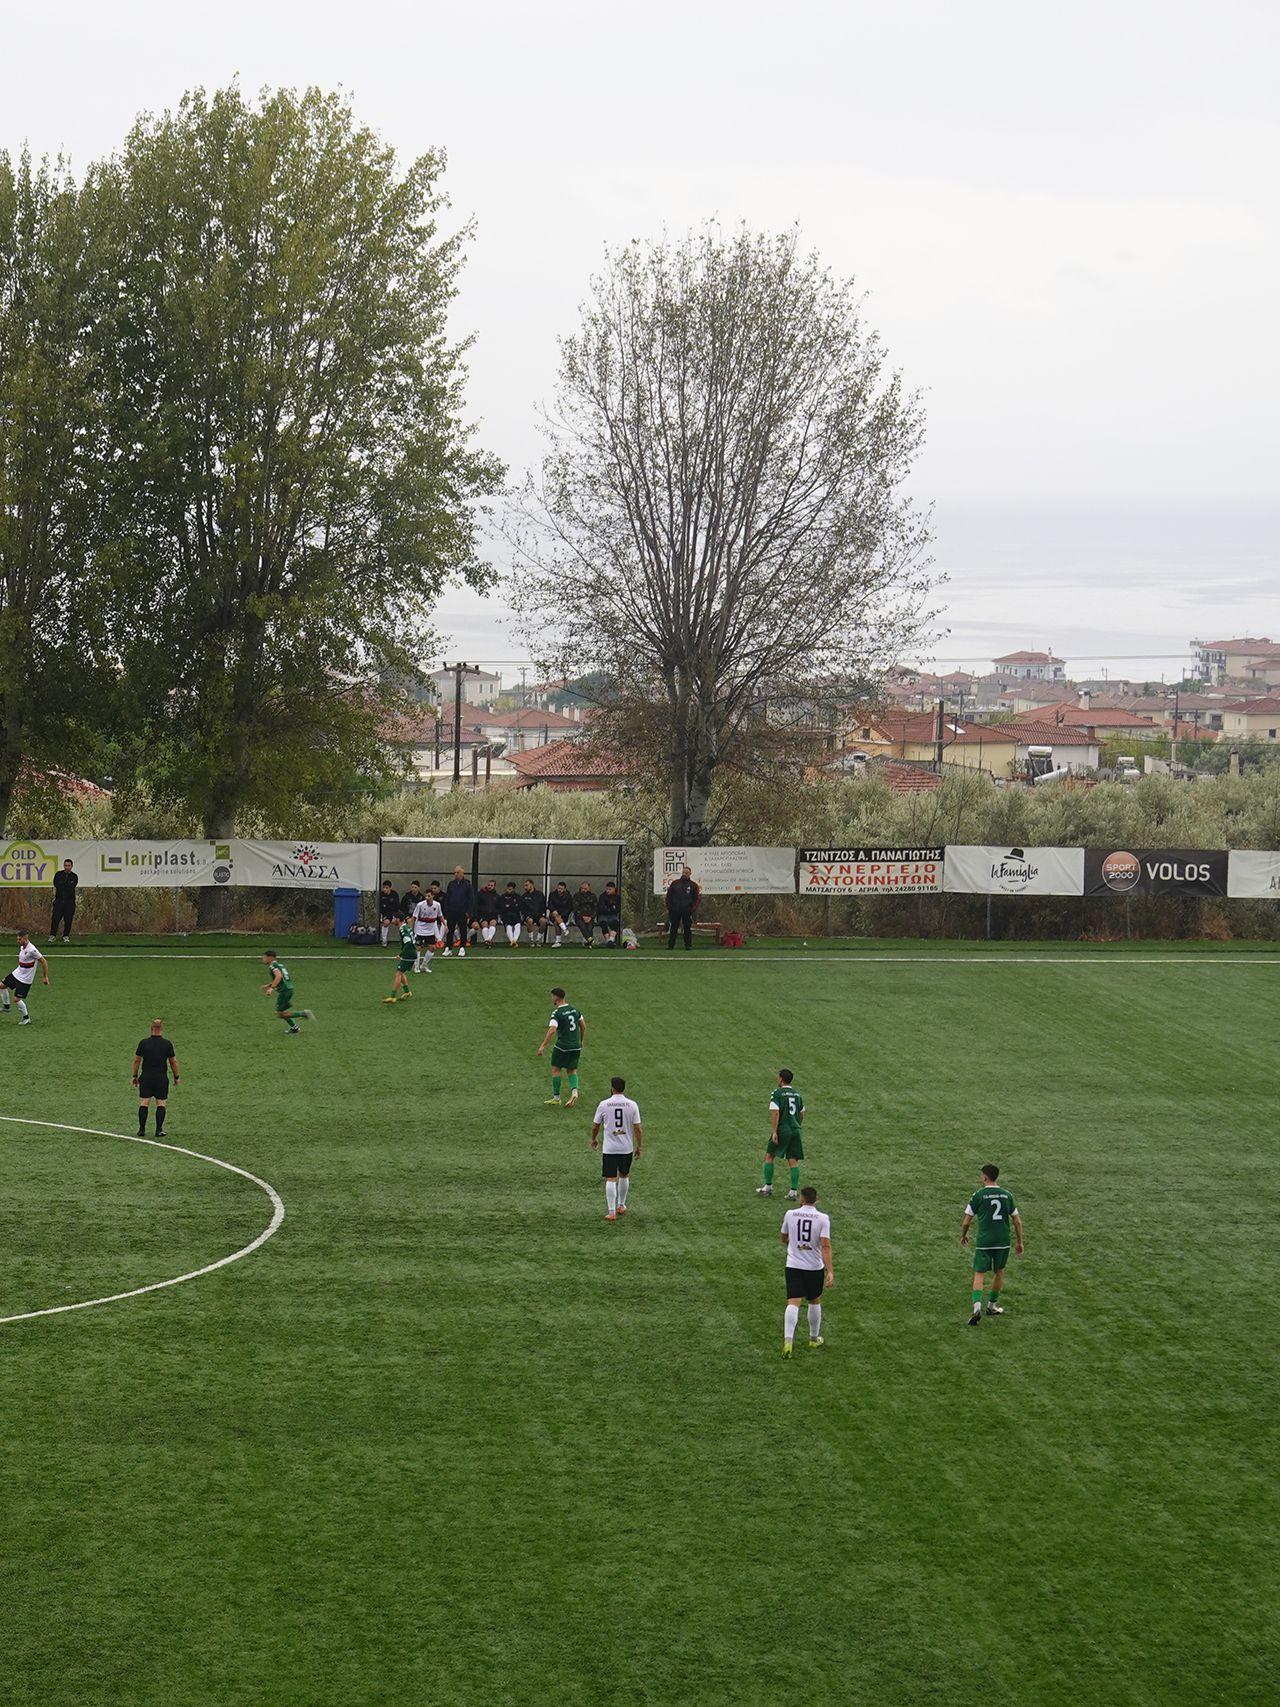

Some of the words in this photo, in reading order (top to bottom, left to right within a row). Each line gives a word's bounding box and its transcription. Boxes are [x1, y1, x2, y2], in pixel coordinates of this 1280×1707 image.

[11, 849, 36, 860] OLD
[125, 846, 195, 869] lariplast
[804, 850, 856, 861] ΤΖΙΝΤΖΟΣ
[858, 850, 869, 861] Α.
[872, 849, 941, 861] ΠΑΝΑΓΙΩΤΗΣ
[809, 863, 936, 875] ΣΥΝΕΡΓΕΙΟ
[1108, 871, 1134, 879] 2000
[1146, 863, 1210, 882] VOLOS
[809, 874, 936, 886] ΑΥΤΟΚΙΝΗΤΩΝ
[568, 1015, 577, 1031] 3
[788, 1097, 797, 1115] 5
[614, 1108, 624, 1128] 9
[990, 1199, 1003, 1220] 2
[797, 1219, 813, 1242] 19
